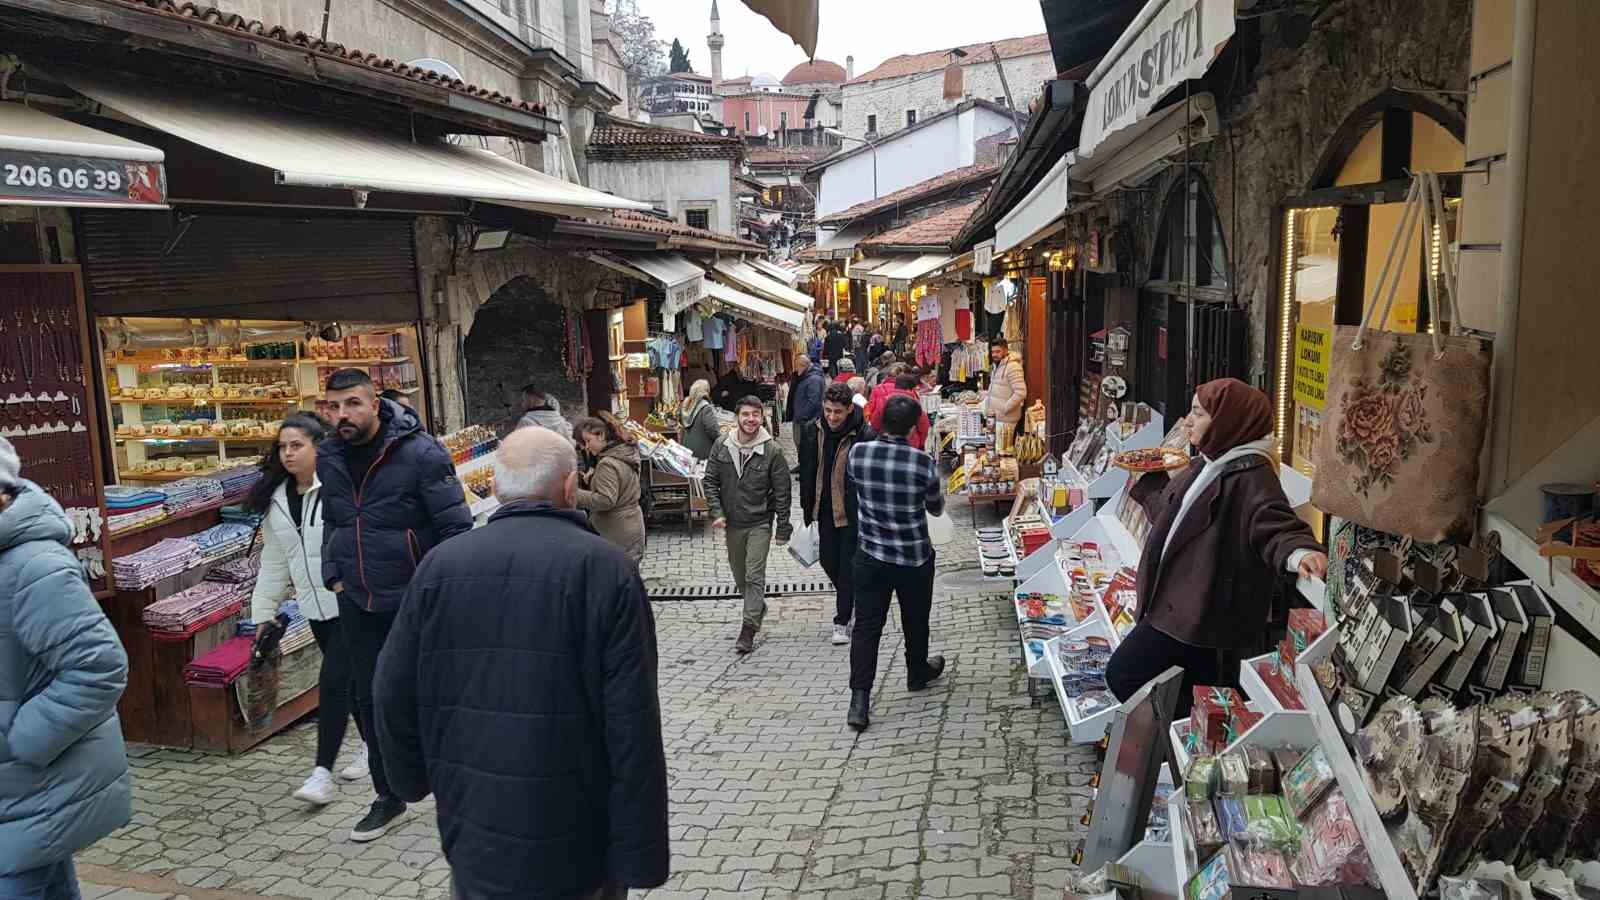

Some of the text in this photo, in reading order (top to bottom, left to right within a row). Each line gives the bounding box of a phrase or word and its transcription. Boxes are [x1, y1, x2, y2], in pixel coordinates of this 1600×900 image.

[4, 163, 121, 191] 206 06 39
[1301, 348, 1320, 363] LOKUM
